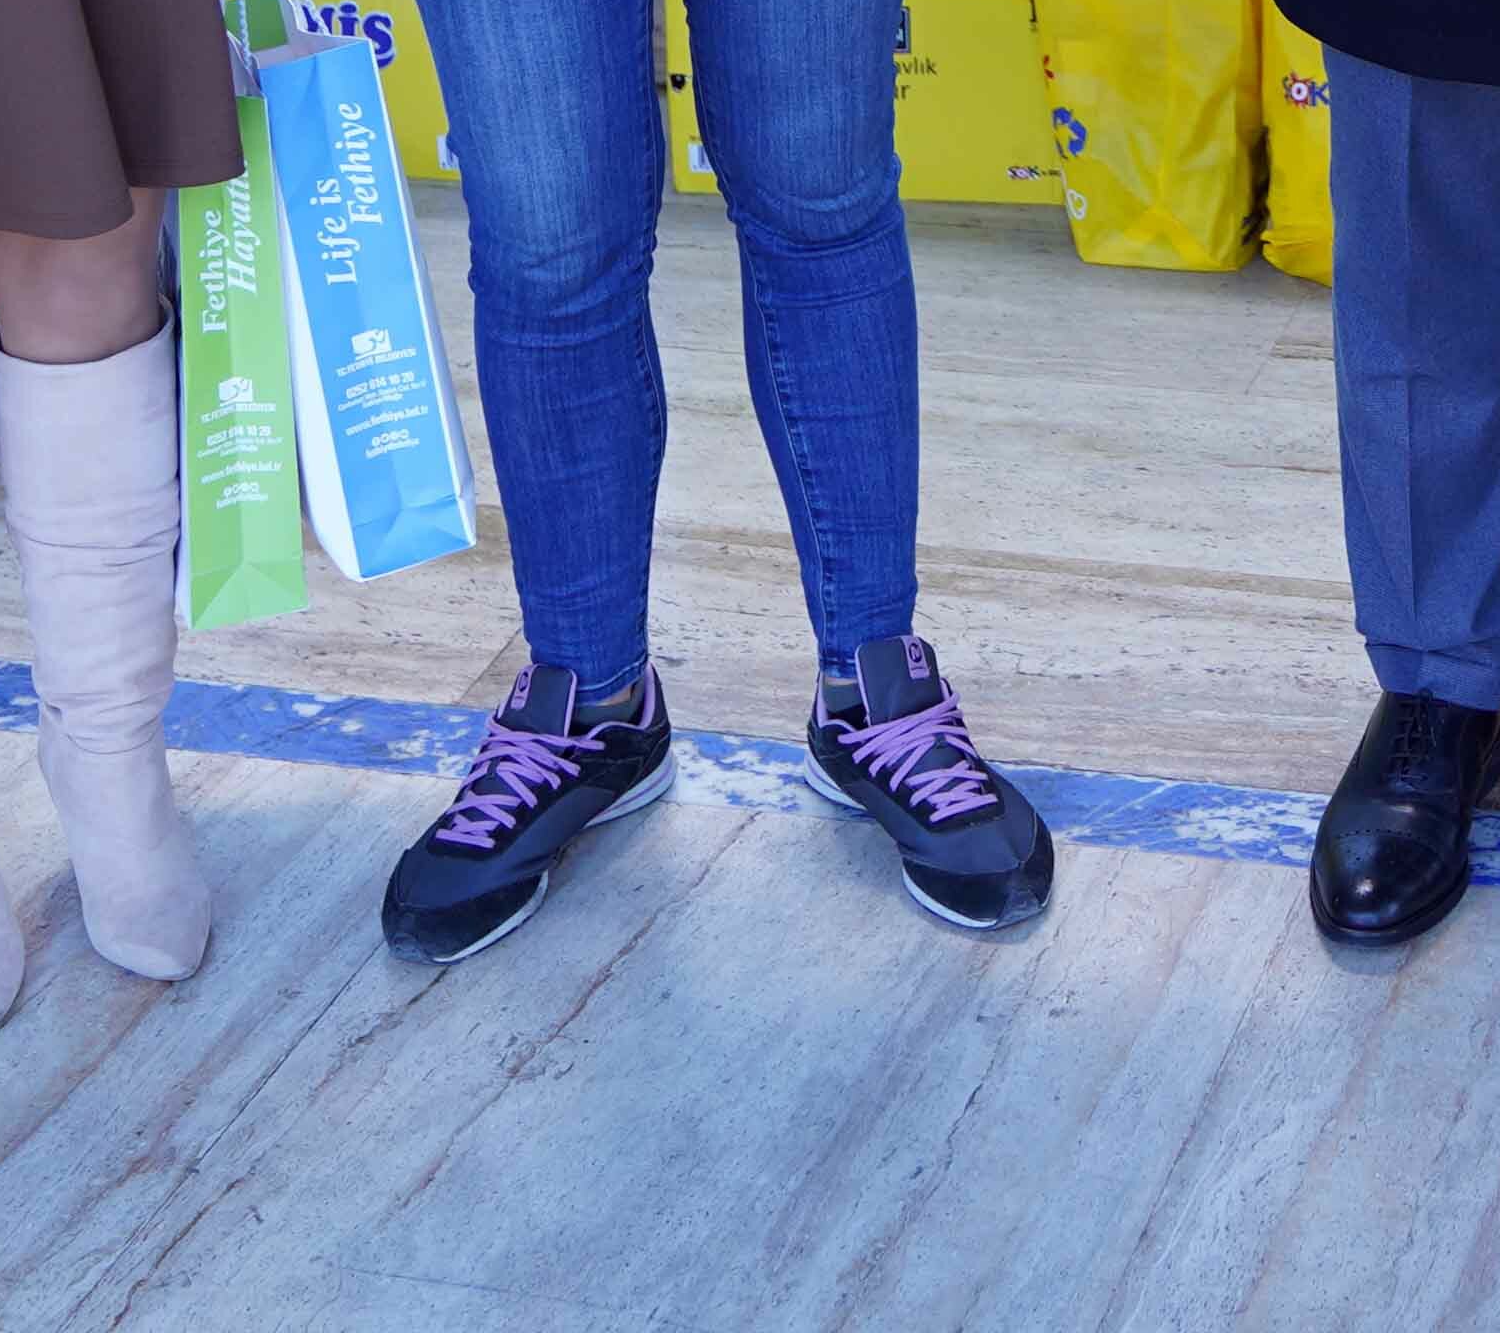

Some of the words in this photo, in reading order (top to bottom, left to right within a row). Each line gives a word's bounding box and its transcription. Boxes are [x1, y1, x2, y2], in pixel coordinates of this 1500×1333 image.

[309, 177, 343, 207] is
[335, 101, 384, 226] Fethiye
[198, 208, 230, 334] Fethiye
[316, 216, 361, 286] Life
